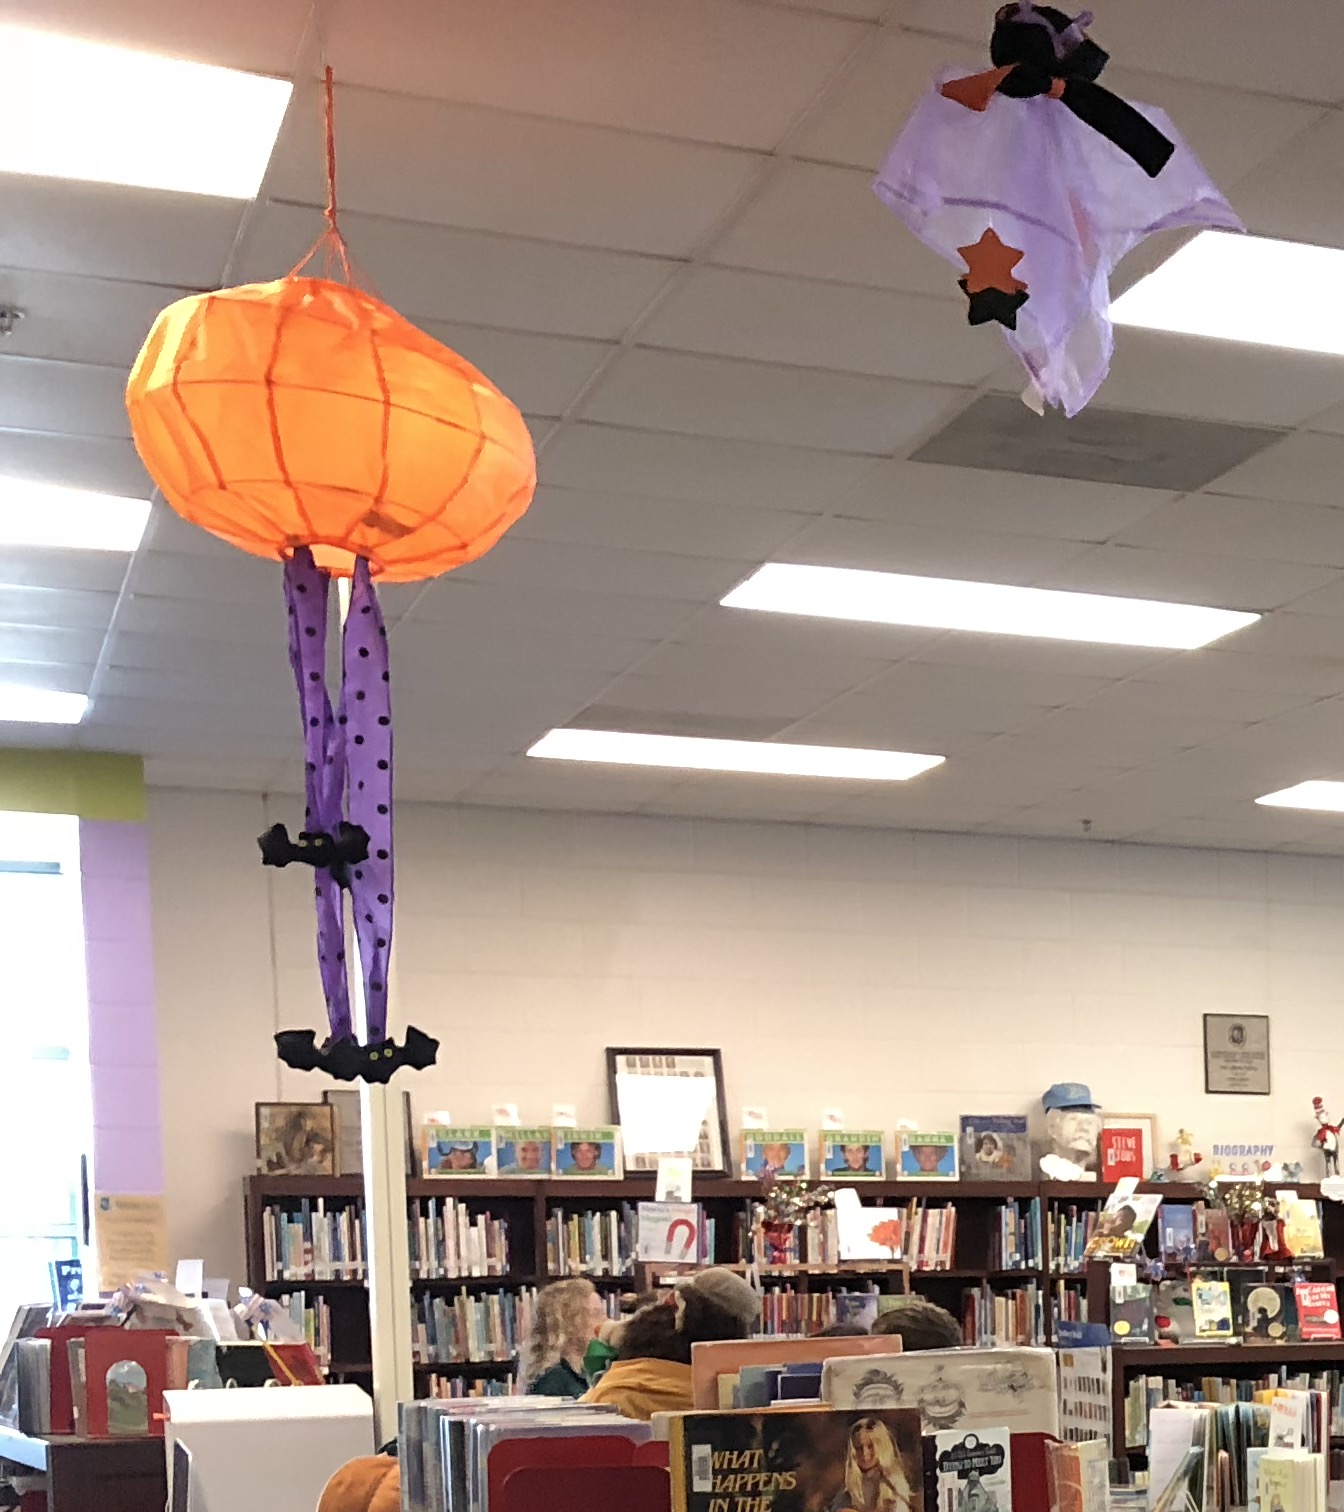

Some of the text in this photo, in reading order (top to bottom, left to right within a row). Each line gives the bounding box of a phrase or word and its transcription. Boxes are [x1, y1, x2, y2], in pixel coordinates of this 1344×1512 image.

[1111, 1136, 1136, 1149] STEVE
[1212, 1144, 1274, 1157] BIOGRAPHY
[710, 1448, 765, 1471] WHAT
[711, 1471, 797, 1493] HAPPENS
